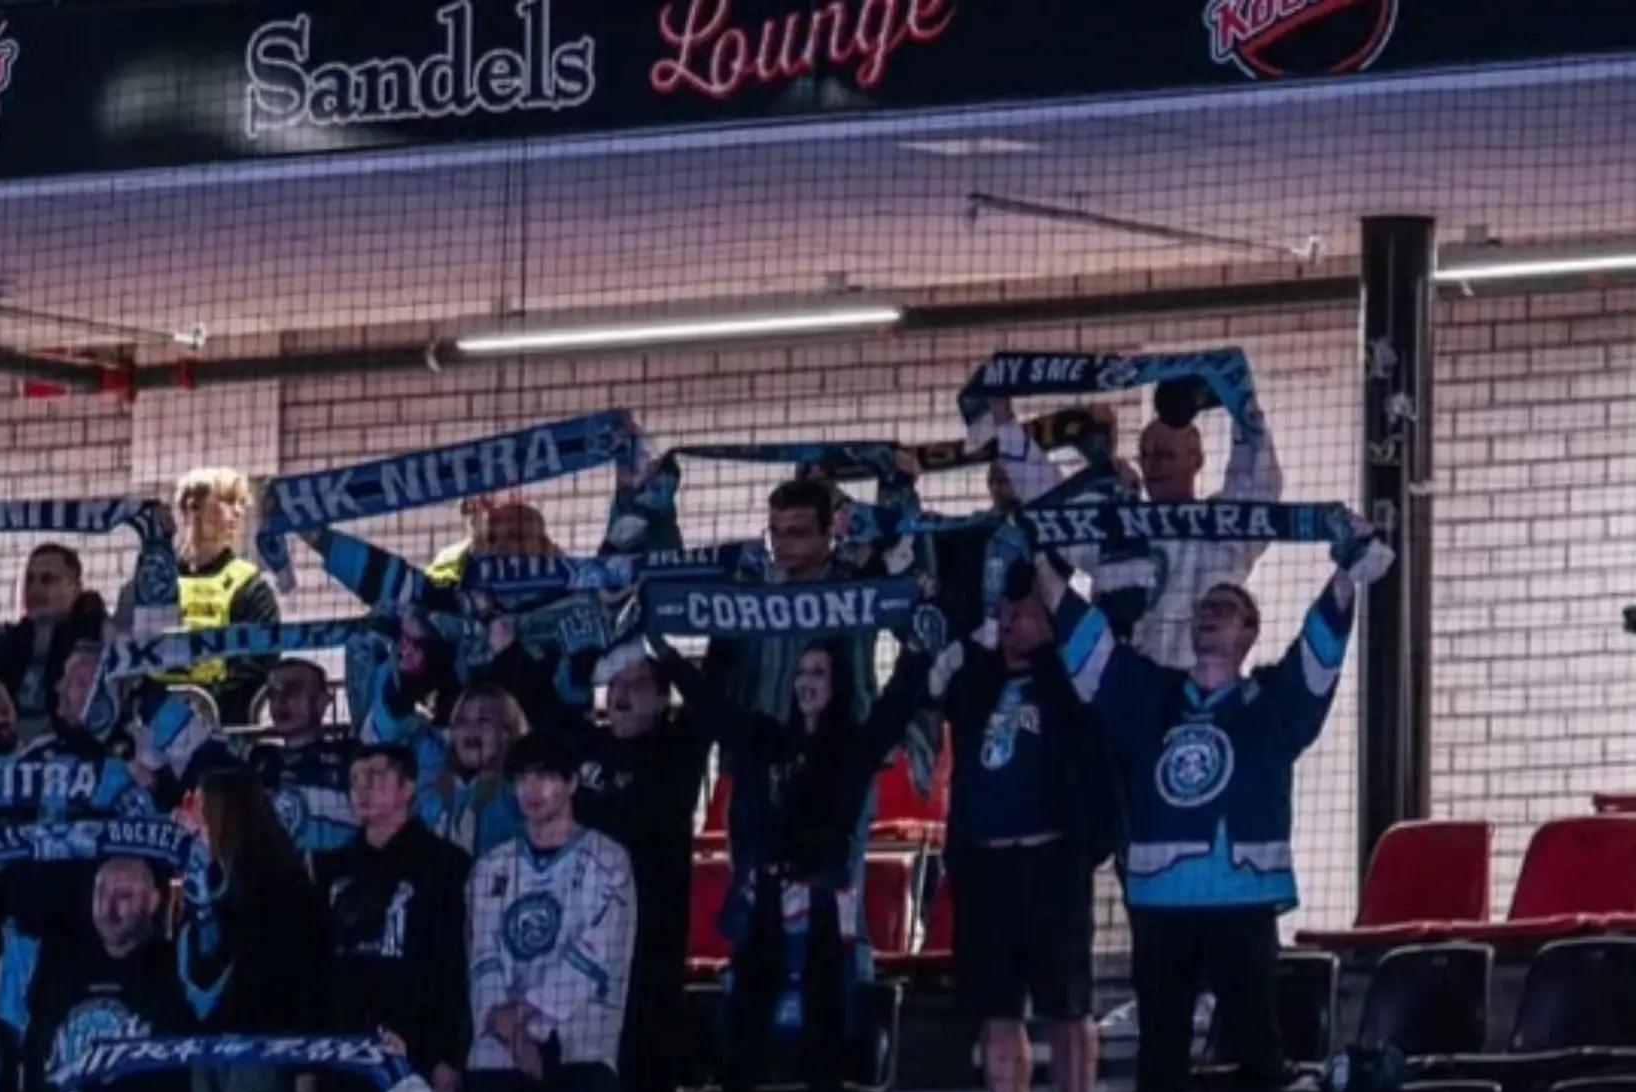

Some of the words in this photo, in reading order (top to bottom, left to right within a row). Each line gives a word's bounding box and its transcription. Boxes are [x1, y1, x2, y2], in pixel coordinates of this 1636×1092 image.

[244, 0, 596, 137] Sandels
[276, 468, 356, 526] HK
[377, 427, 562, 506] NITRA
[1036, 511, 1108, 542] HK
[1118, 504, 1277, 539] NITRA
